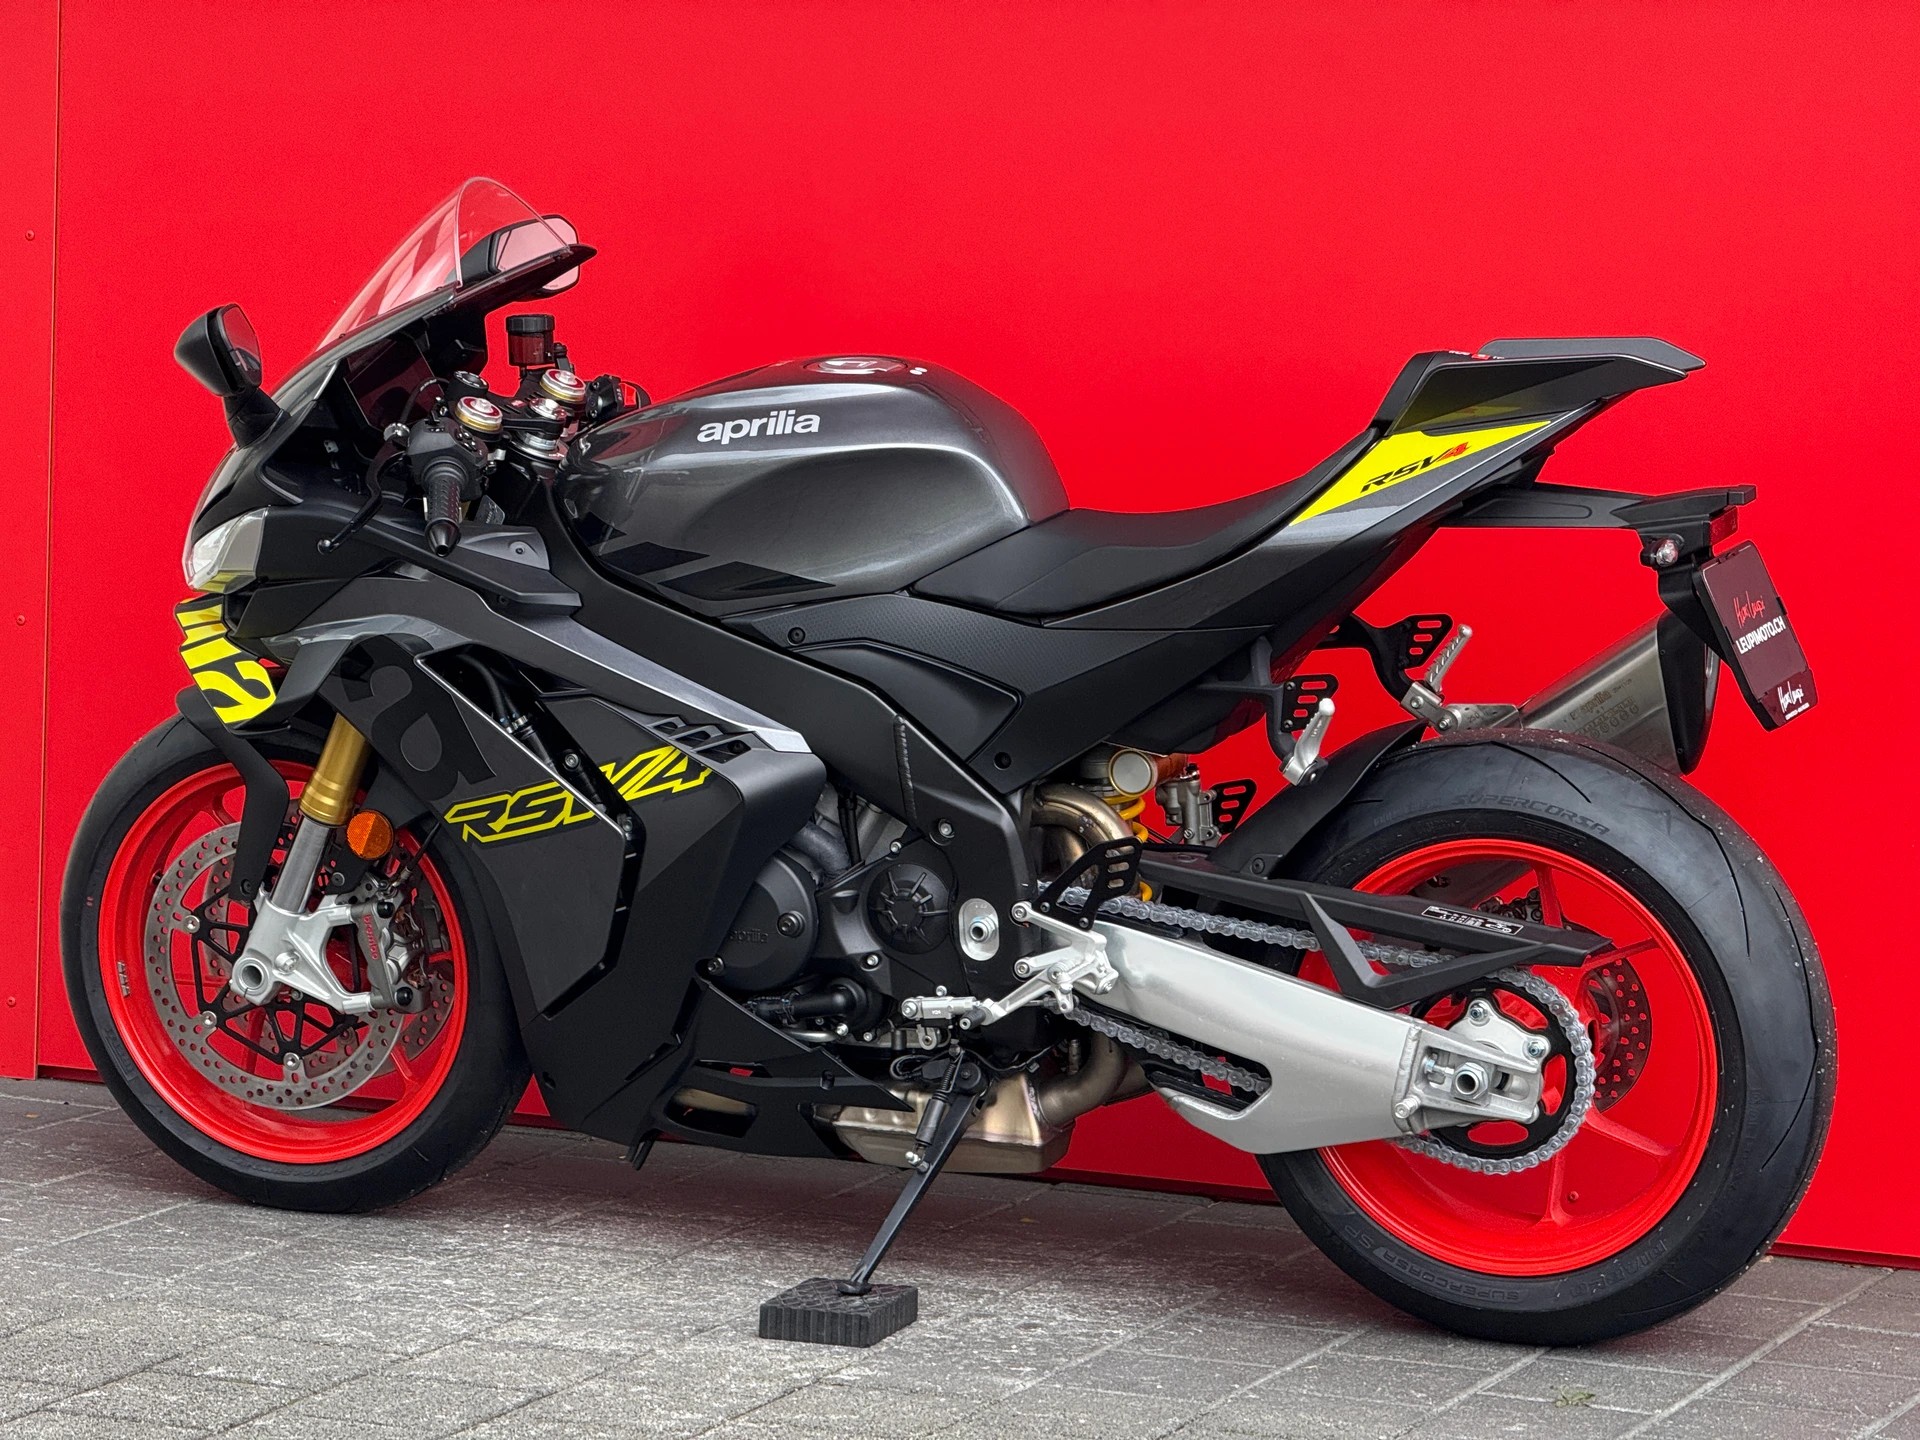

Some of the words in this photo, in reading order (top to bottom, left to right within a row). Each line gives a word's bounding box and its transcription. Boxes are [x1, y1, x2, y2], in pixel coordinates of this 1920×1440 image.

[696, 409, 821, 445] aprilia
[1360, 442, 1471, 493] RSV4
[1736, 615, 1786, 654] LEUPIMOTO.CH
[1450, 794, 1611, 836] SUPERCORSA
[363, 913, 379, 960] brembo
[1383, 1250, 1520, 1303] SUPERCORSA
